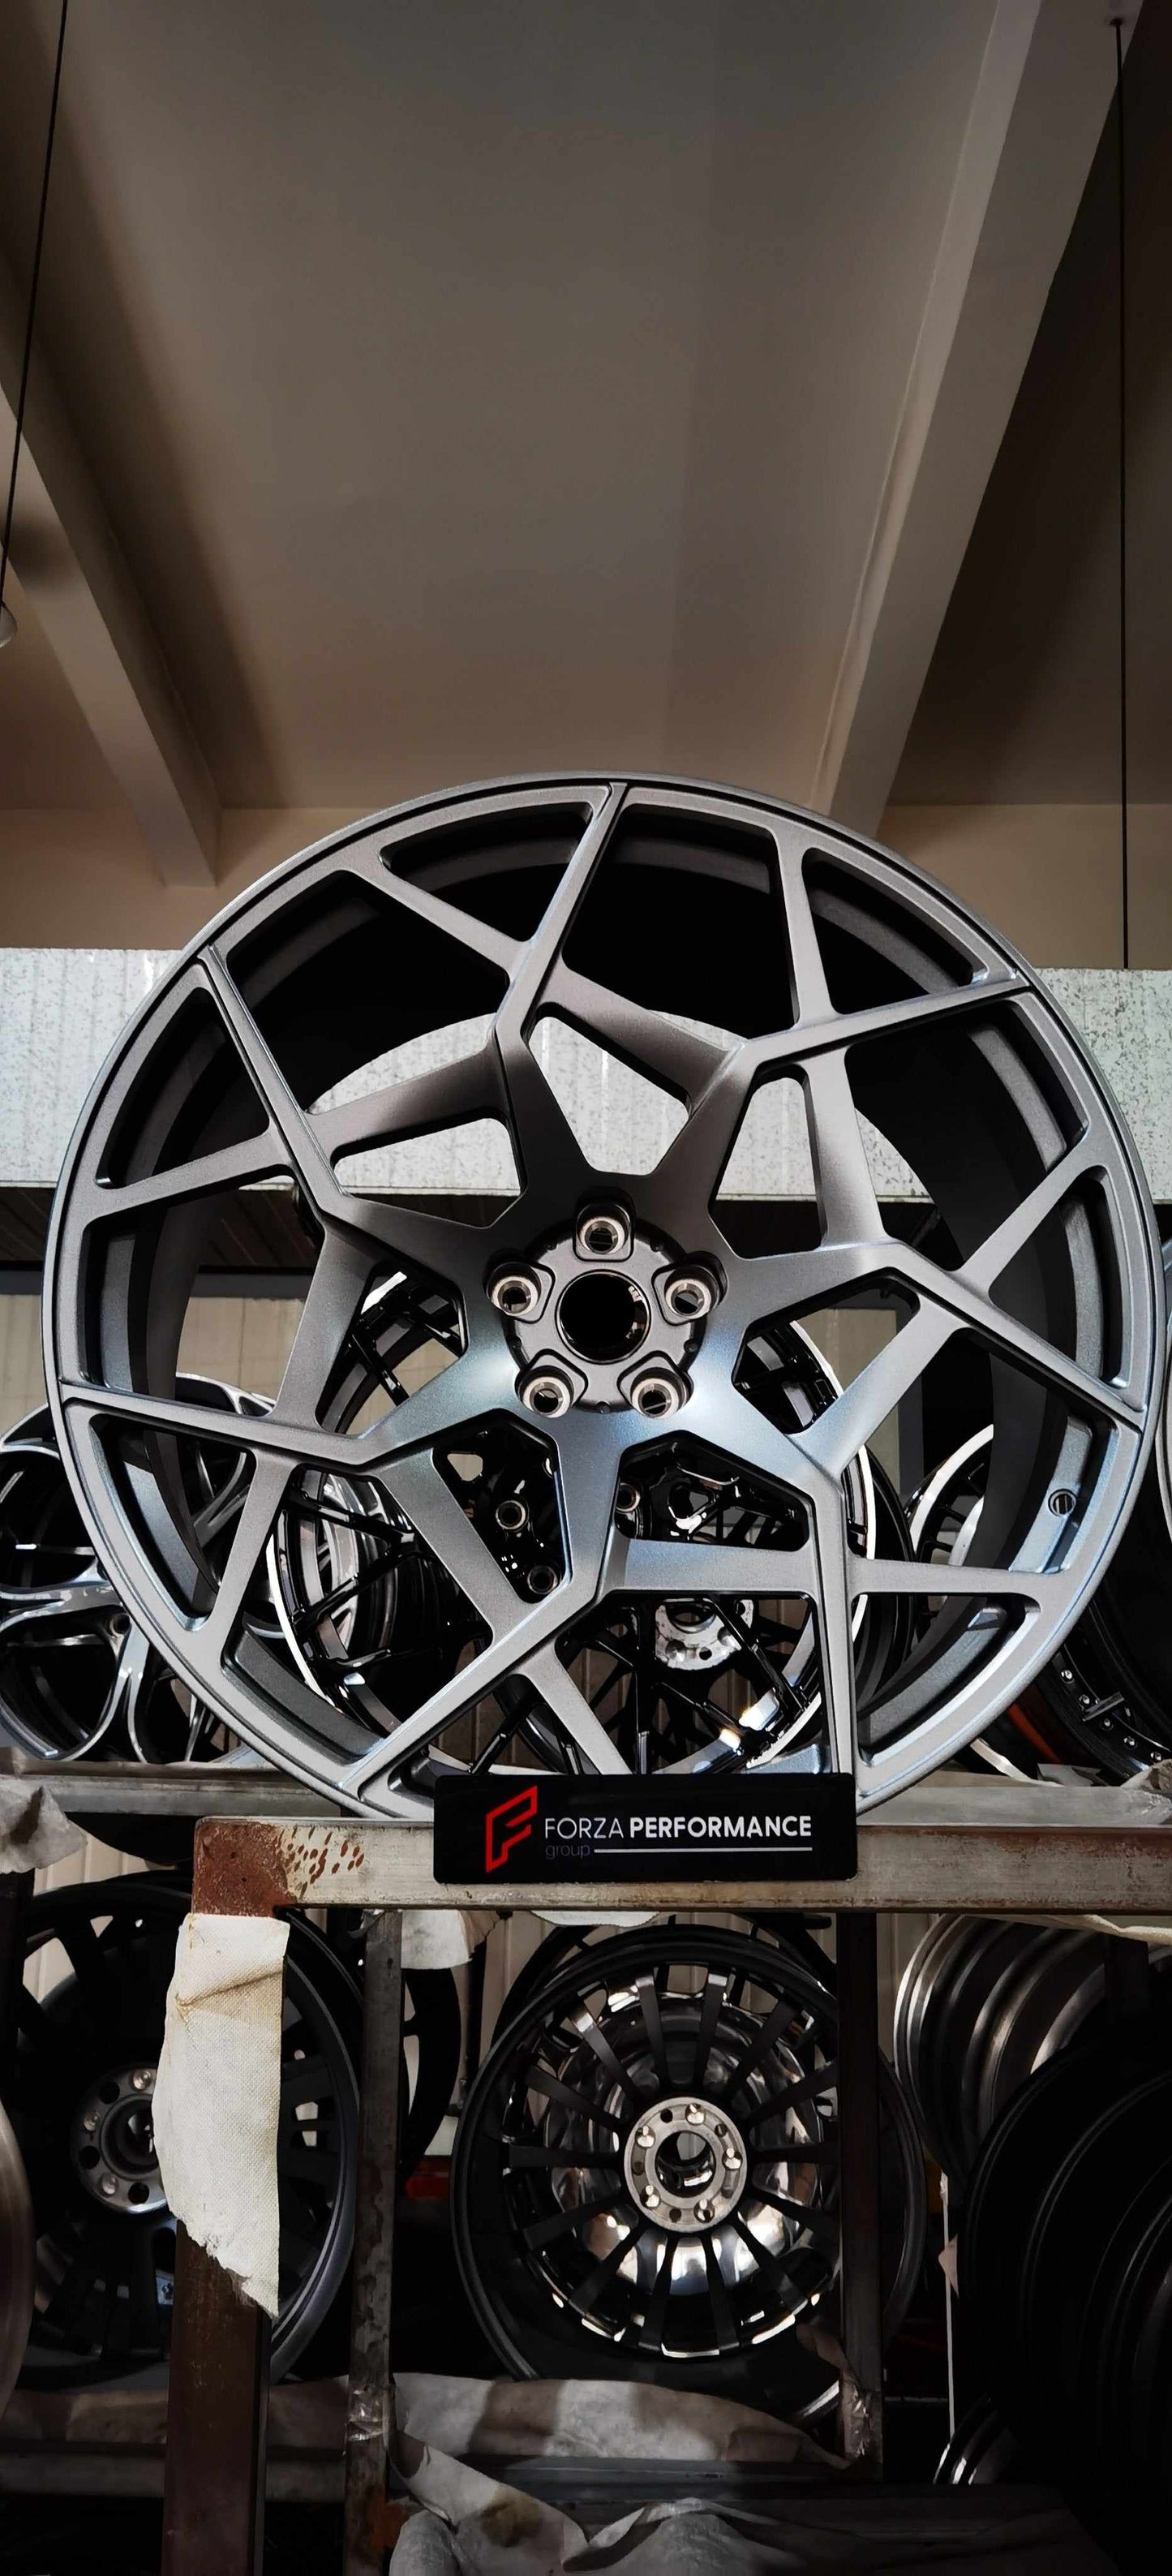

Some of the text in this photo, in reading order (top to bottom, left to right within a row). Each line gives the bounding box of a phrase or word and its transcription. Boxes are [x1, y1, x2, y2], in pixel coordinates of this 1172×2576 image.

[544, 1815, 812, 1839] FORZA PERFORMANCE
[545, 1843, 591, 1860] group
